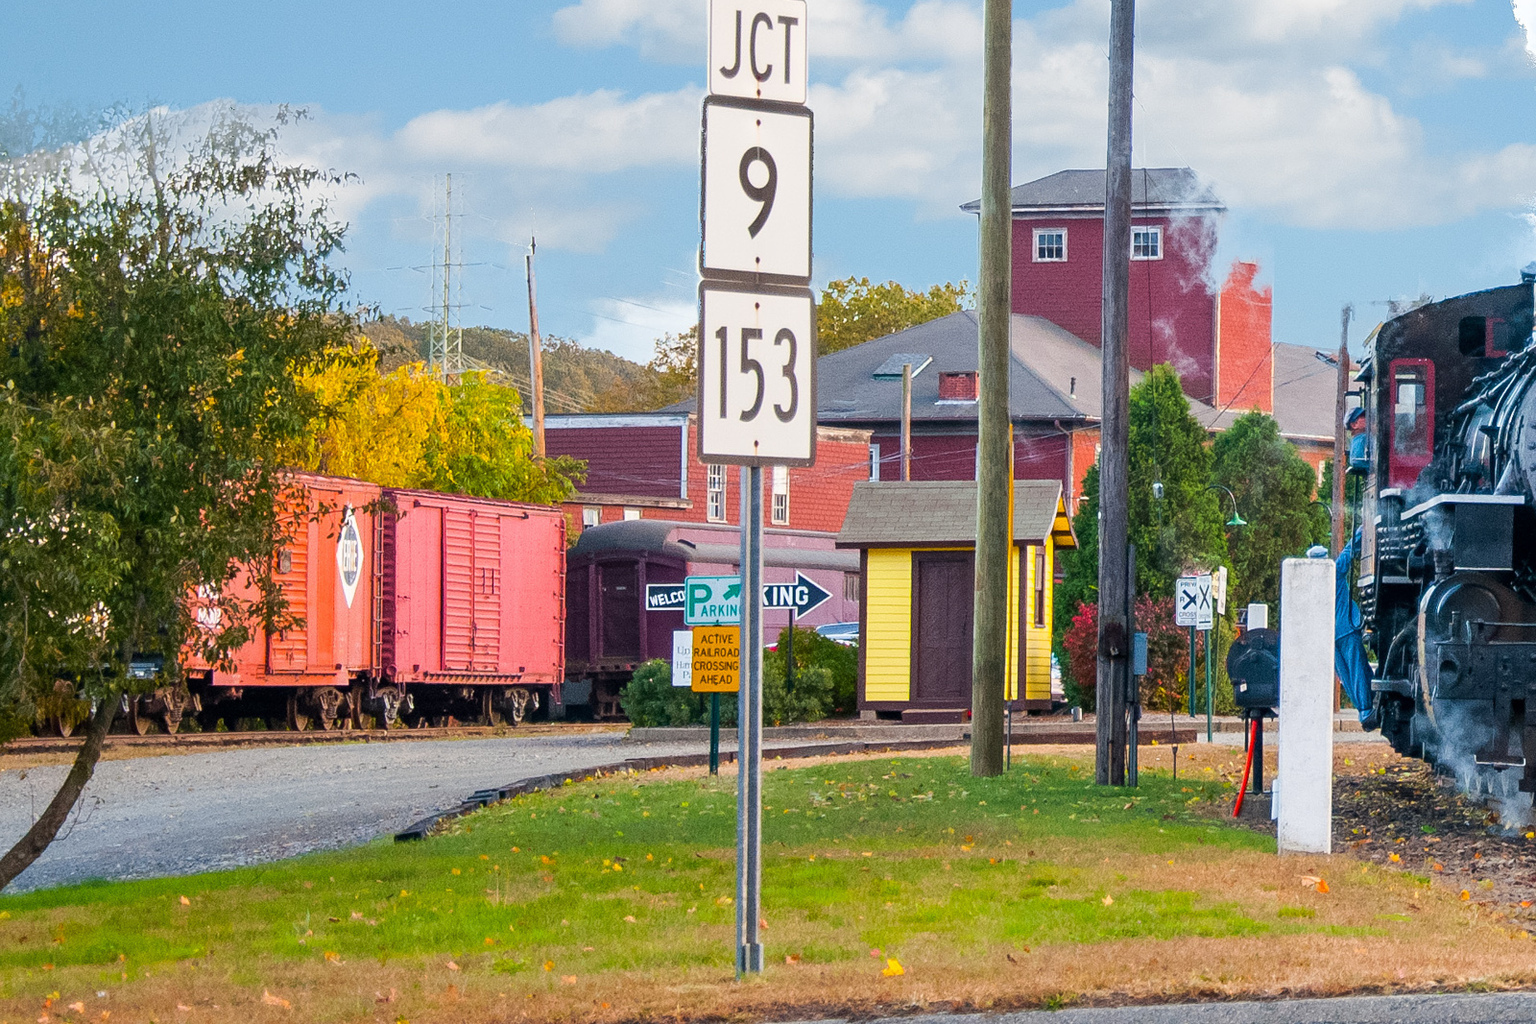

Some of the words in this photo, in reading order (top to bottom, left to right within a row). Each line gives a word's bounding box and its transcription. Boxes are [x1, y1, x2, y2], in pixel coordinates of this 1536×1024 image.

[719, 9, 799, 85] JCT
[738, 145, 778, 240] 9
[715, 325, 799, 423] 153
[649, 590, 686, 607] WELCO
[689, 583, 741, 618] PARKIN
[700, 633, 734, 644] ACTIVE
[693, 647, 740, 658] RAILROAD
[693, 660, 739, 671] CROSSING
[699, 674, 733, 685] AHEAD
